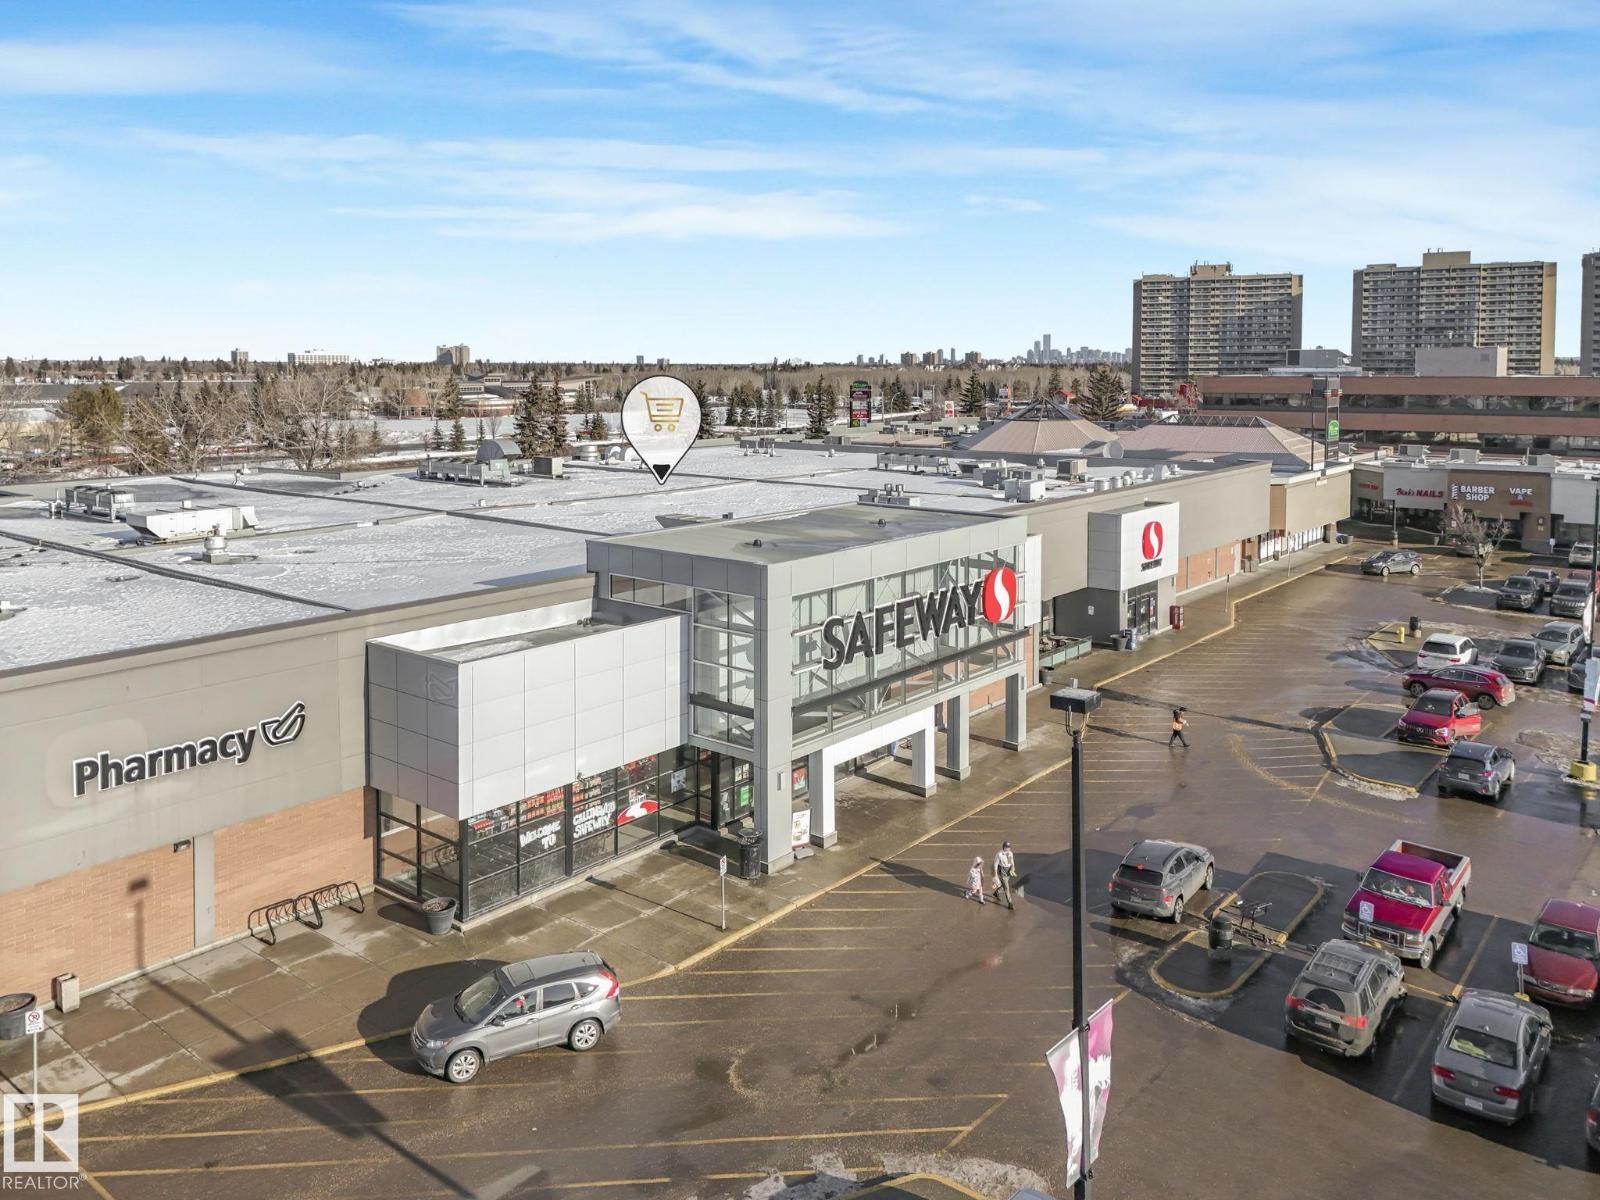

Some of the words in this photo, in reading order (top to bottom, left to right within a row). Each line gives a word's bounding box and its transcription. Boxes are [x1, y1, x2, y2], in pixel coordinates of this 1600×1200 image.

[1416, 489, 1444, 498] NAILS
[1460, 485, 1495, 495] BARBER
[1466, 493, 1490, 502] SHOP
[1509, 487, 1533, 495] VAPE
[822, 579, 985, 670] SAFEWAY
[73, 726, 257, 797] Pharmacy
[519, 820, 561, 848] WELCOME
[573, 813, 611, 838] SAFEWAY
[541, 833, 556, 850] TO
